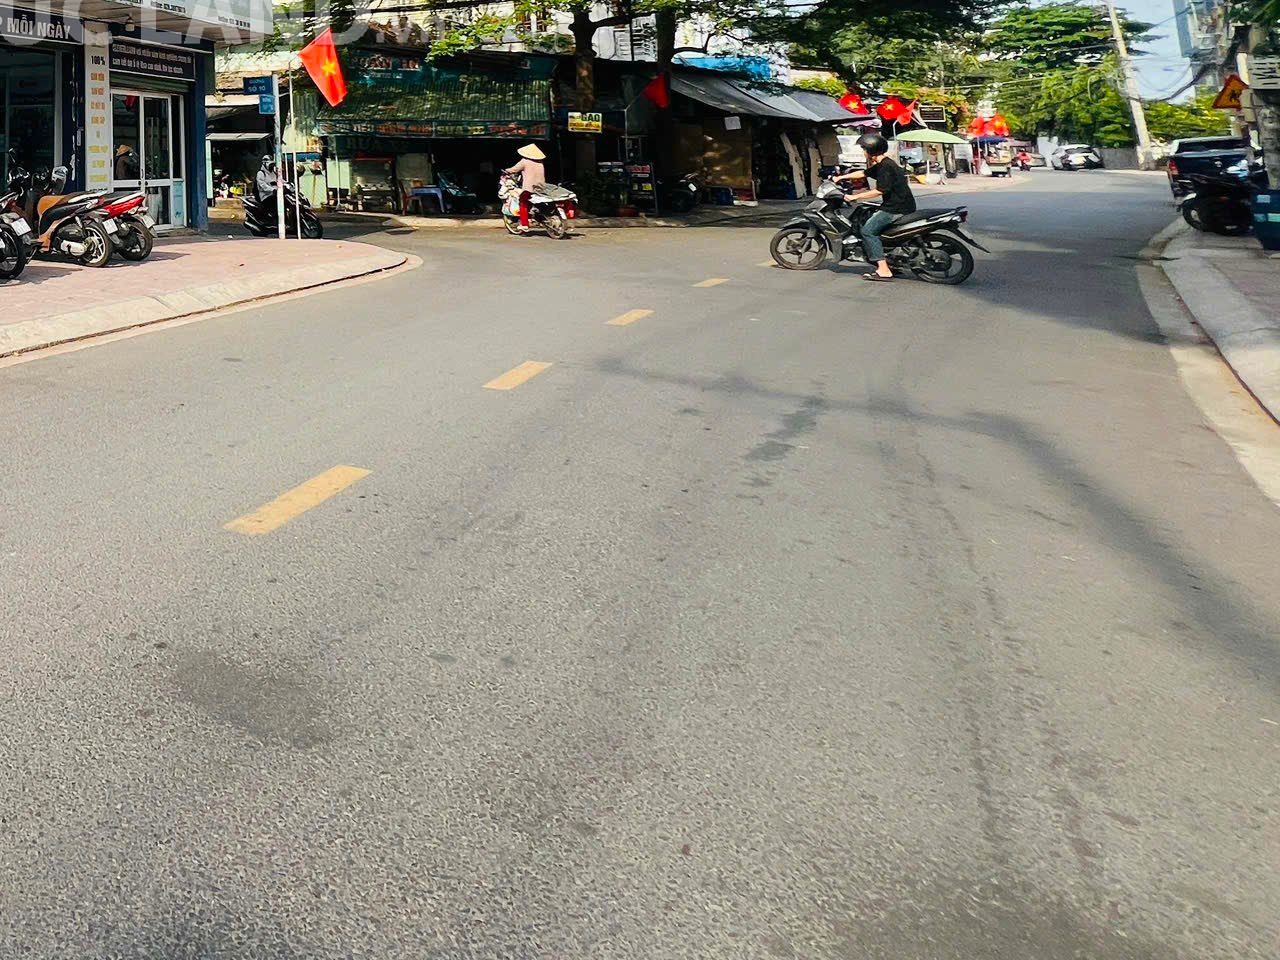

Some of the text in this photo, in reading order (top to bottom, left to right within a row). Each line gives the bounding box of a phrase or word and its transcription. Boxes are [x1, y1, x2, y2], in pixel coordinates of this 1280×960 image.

[7, 14, 33, 35] MỖI
[37, 20, 71, 40] NGÀY
[90, 55, 106, 66] 100%
